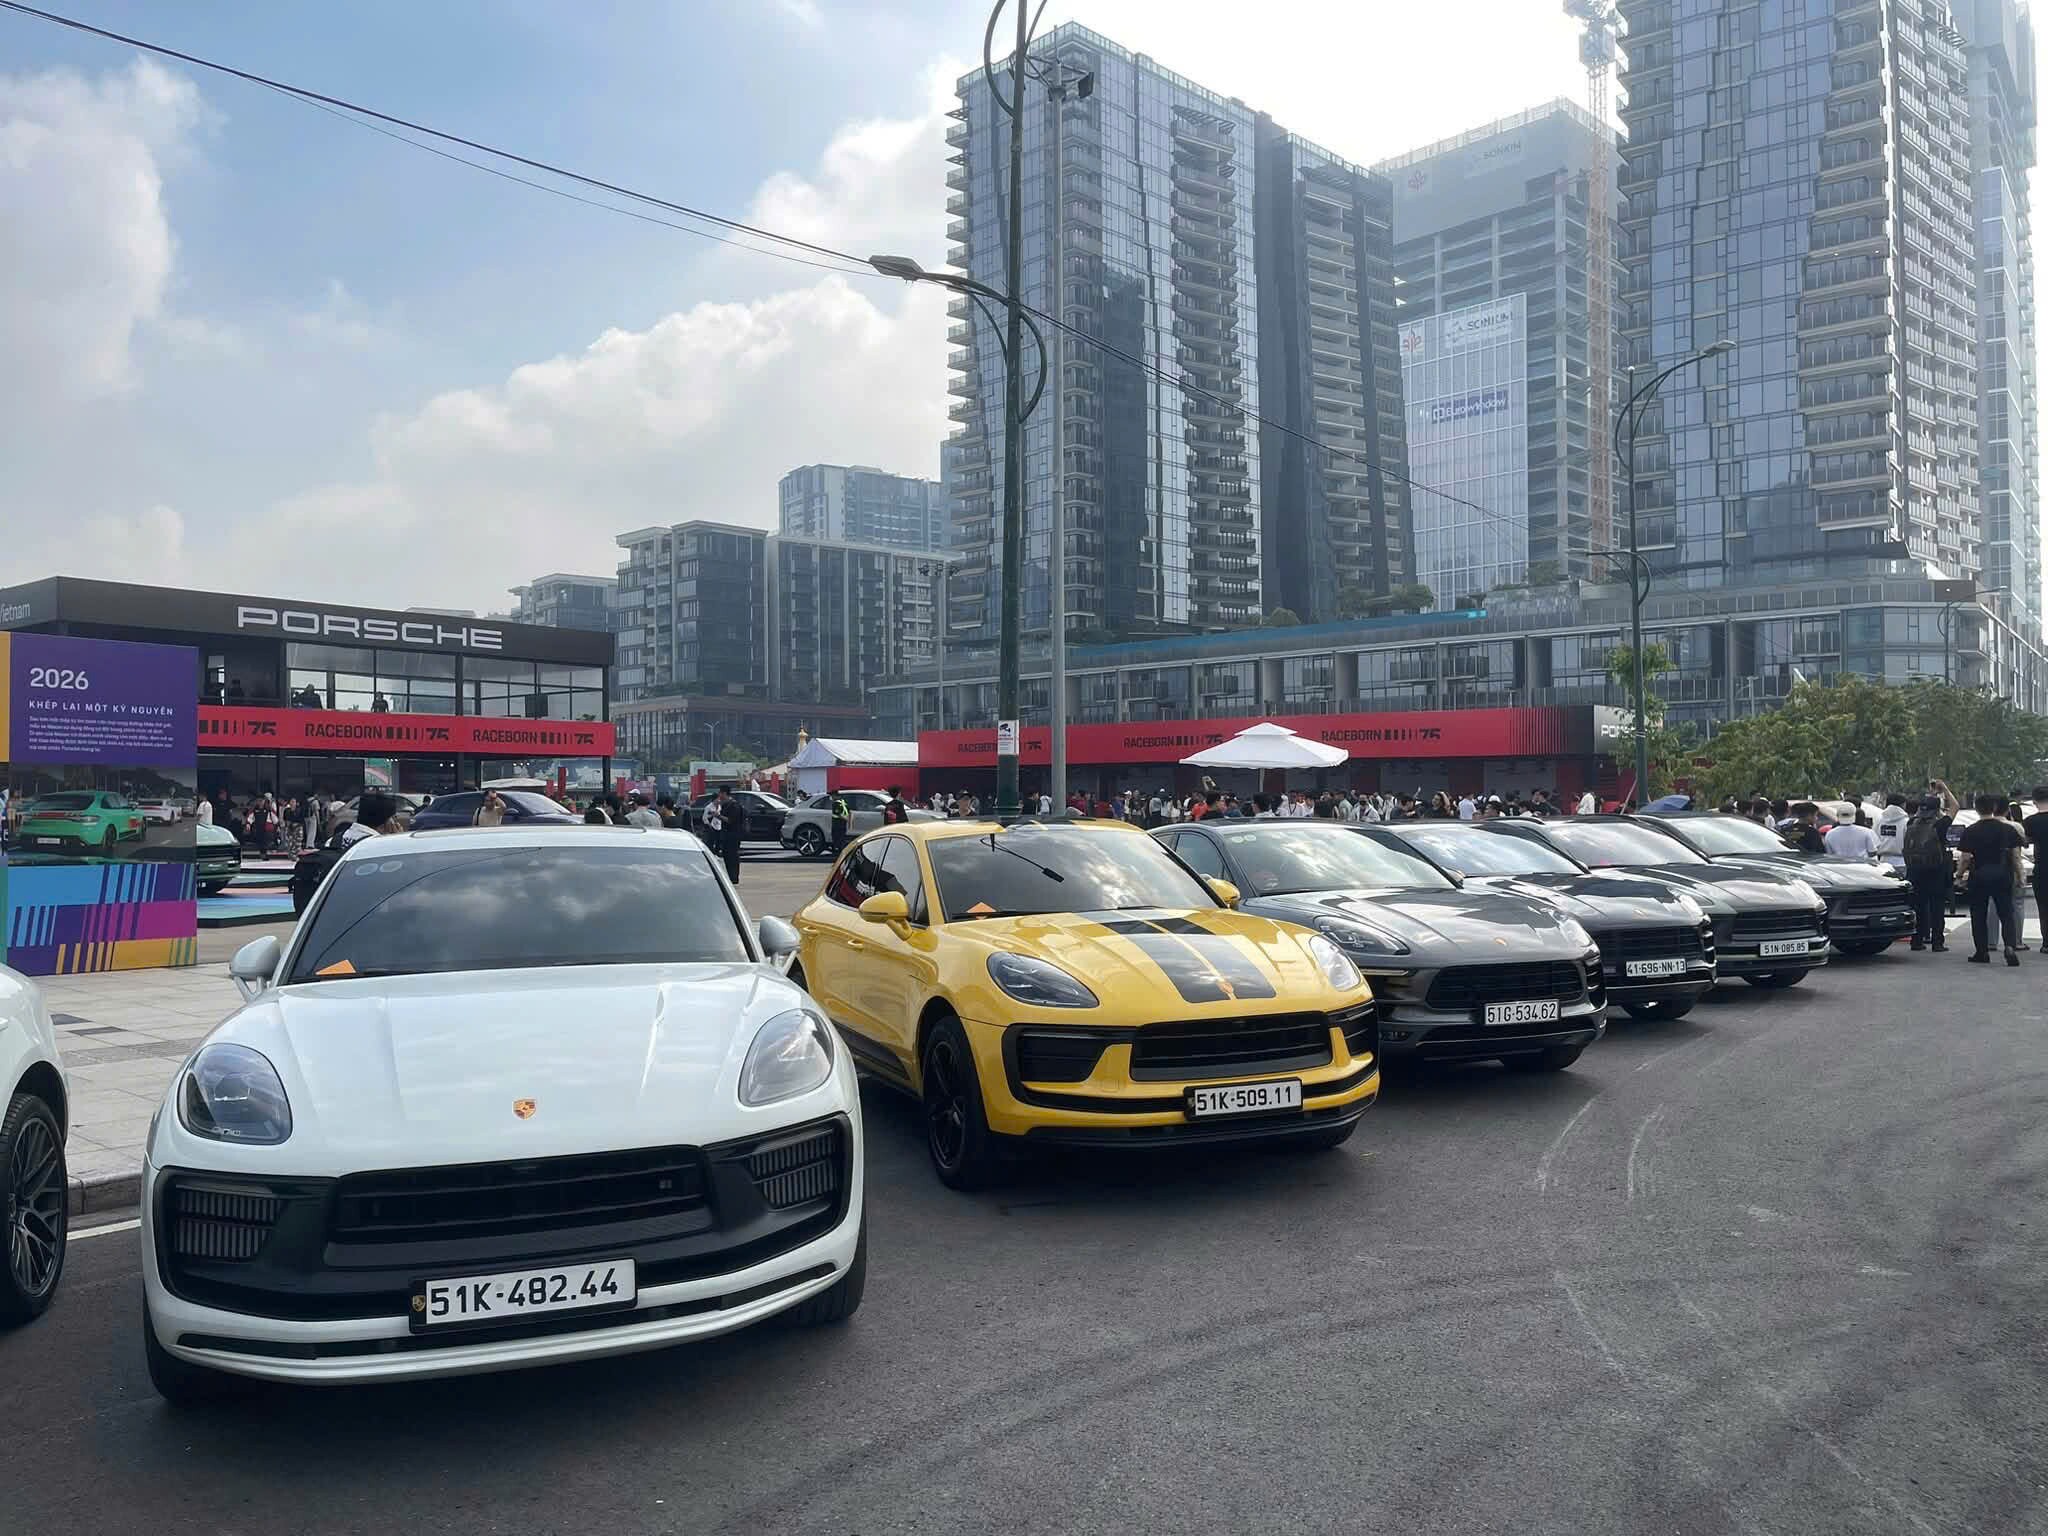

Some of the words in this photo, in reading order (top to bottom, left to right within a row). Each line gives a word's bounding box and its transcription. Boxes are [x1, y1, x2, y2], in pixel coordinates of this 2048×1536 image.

[237, 606, 502, 649] PORSCHE
[29, 667, 89, 690] 2026
[29, 699, 58, 710] KHÉP
[131, 705, 174, 716] NGUYÊN
[305, 723, 382, 739] RACEBORN
[473, 729, 537, 744] RACEBORN
[1321, 729, 1381, 741] RACEBORN
[1123, 735, 1174, 748] RACEBORN
[1487, 1003, 1556, 1023] 51G-534.62
[1197, 1086, 1291, 1111] 51K-509.11
[430, 1267, 618, 1316] 51K-482.44
